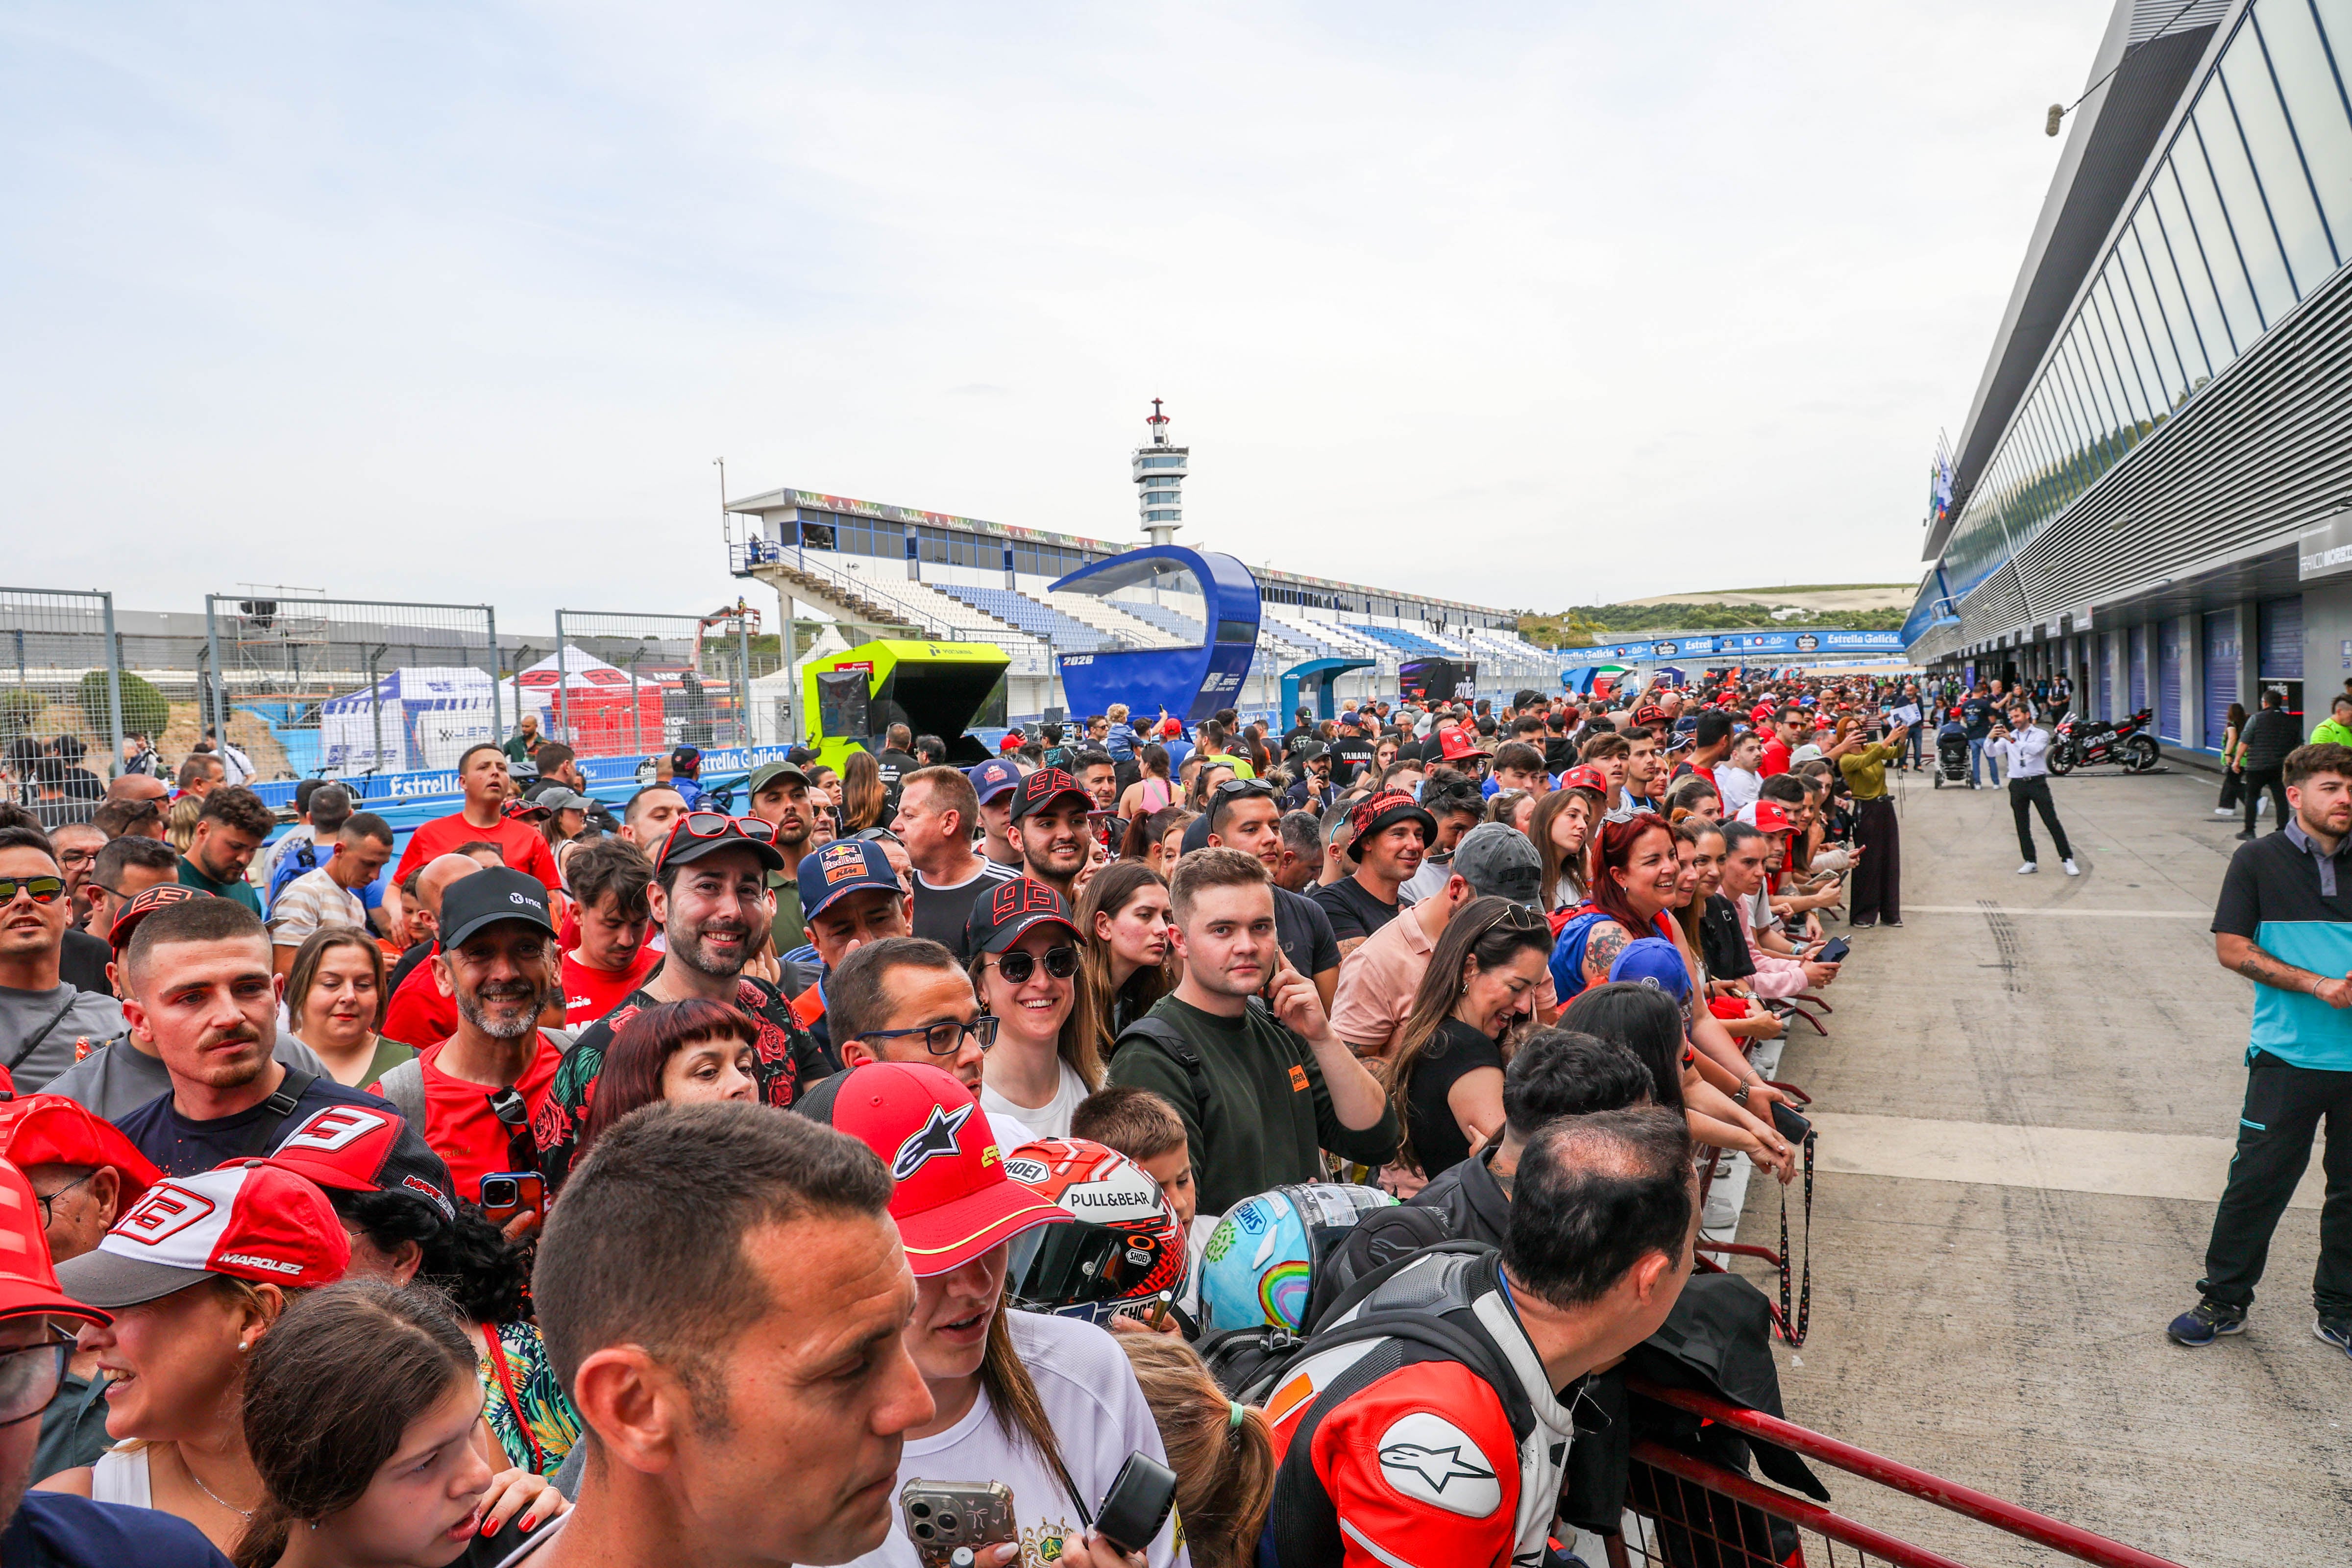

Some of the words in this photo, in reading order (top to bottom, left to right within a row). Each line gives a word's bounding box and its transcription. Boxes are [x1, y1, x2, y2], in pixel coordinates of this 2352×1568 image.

[1685, 639, 1713, 650] Estrell
[1827, 634, 1861, 644] Estrella
[1864, 634, 1898, 644] Galicia
[1063, 655, 1094, 666] 2026
[1585, 649, 1615, 659] Galicia
[1454, 676, 1474, 700] aprilia
[698, 753, 738, 773] strella
[1027, 768, 1078, 802] 93
[822, 858, 844, 872] Red
[844, 853, 863, 865] Bull
[835, 865, 857, 878] KTM
[993, 877, 1060, 926] 93
[1004, 1160, 1043, 1180] HOEI
[1071, 1191, 1150, 1207] PULL&BEAR
[1236, 1202, 1264, 1230] SHOEI
[219, 1251, 303, 1275] MARQUEZ
[1129, 1251, 1148, 1264] SHOEI
